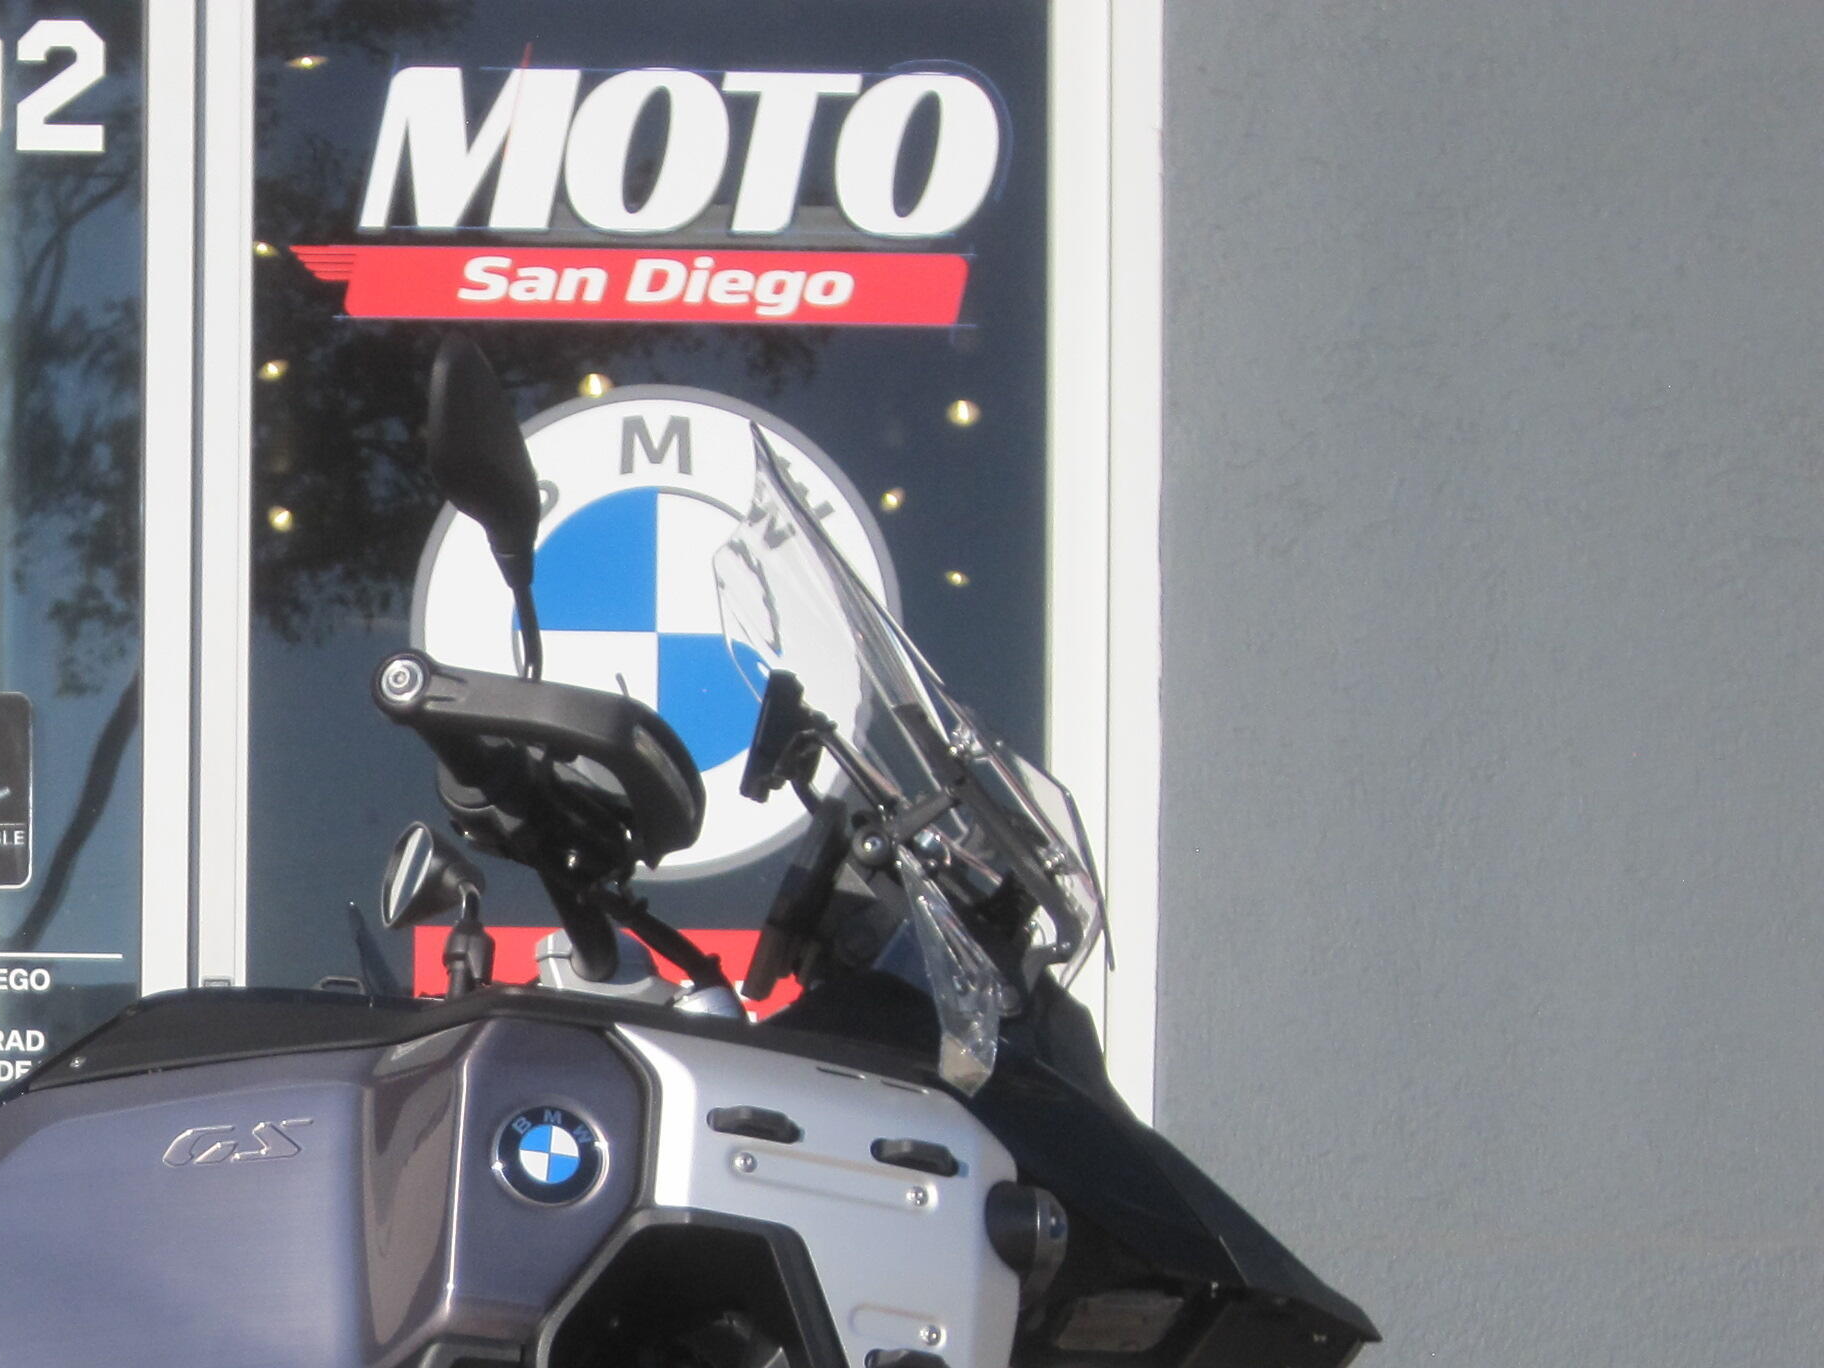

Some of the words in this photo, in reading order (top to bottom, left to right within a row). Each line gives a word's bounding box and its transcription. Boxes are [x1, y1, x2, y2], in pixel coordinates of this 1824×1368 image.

[358, 66, 1000, 237] MOTO
[458, 255, 607, 303] San
[625, 256, 856, 316] Diego
[510, 1110, 593, 1145] BMW
